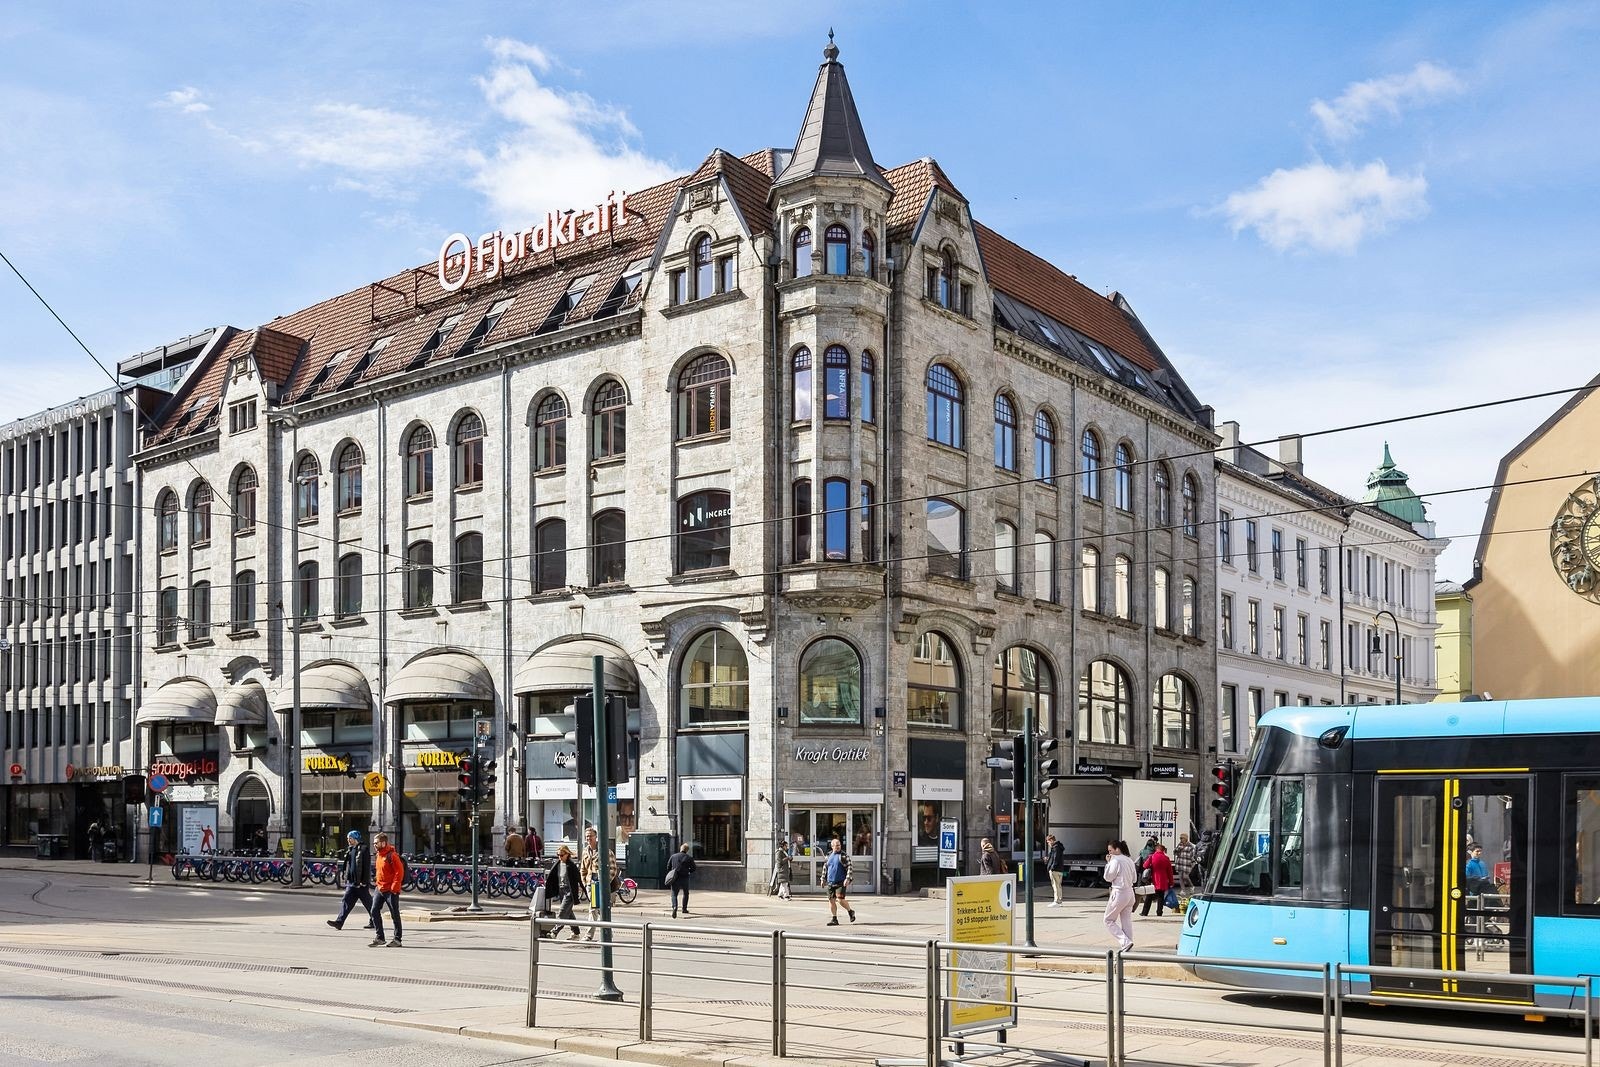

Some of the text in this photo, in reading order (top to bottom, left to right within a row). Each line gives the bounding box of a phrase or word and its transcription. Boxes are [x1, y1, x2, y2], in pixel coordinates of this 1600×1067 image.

[477, 191, 629, 279] Fjordkraft
[304, 755, 338, 770] FOREX
[416, 751, 455, 767] FOREX
[795, 746, 870, 764] Krogh Optikk
[971, 916, 989, 924] stopper
